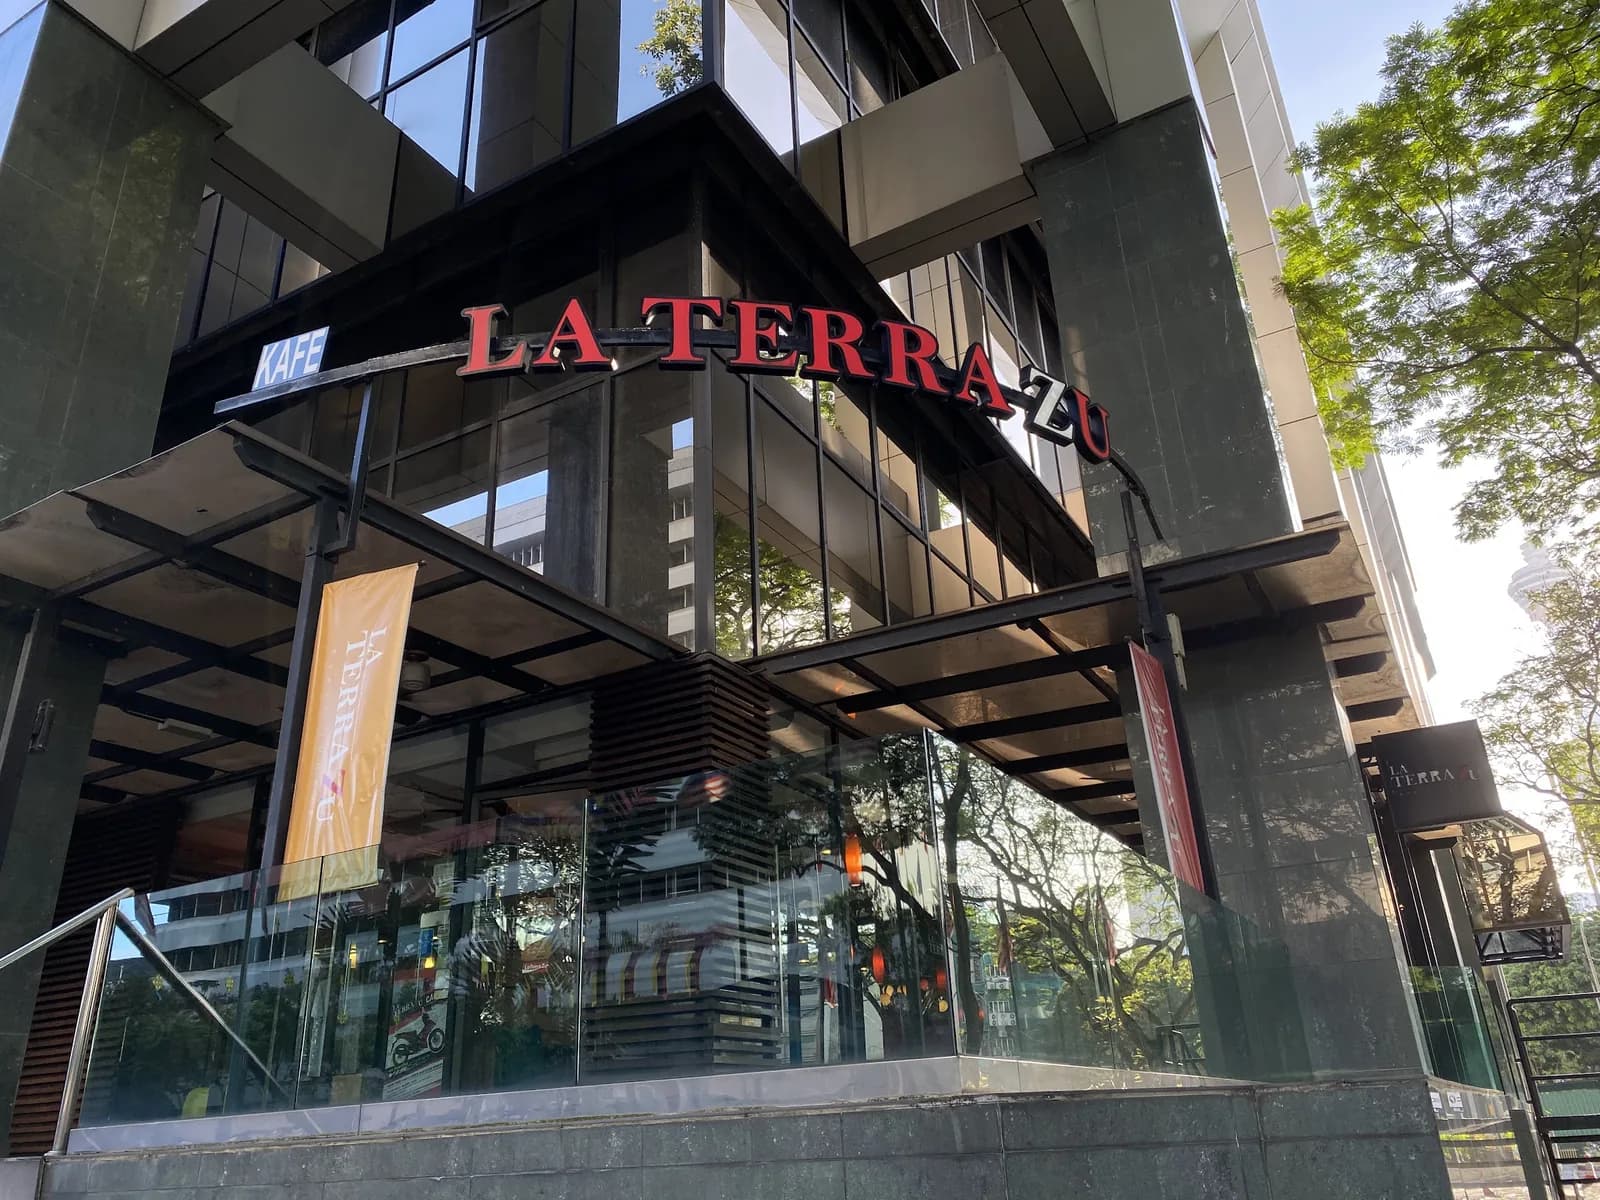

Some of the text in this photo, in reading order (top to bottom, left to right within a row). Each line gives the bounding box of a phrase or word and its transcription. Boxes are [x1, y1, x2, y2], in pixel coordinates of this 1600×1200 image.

[253, 331, 327, 389] KAFE
[457, 296, 1111, 459] LA TERRAZU
[366, 625, 387, 669] LA
[1389, 764, 1409, 777] LA
